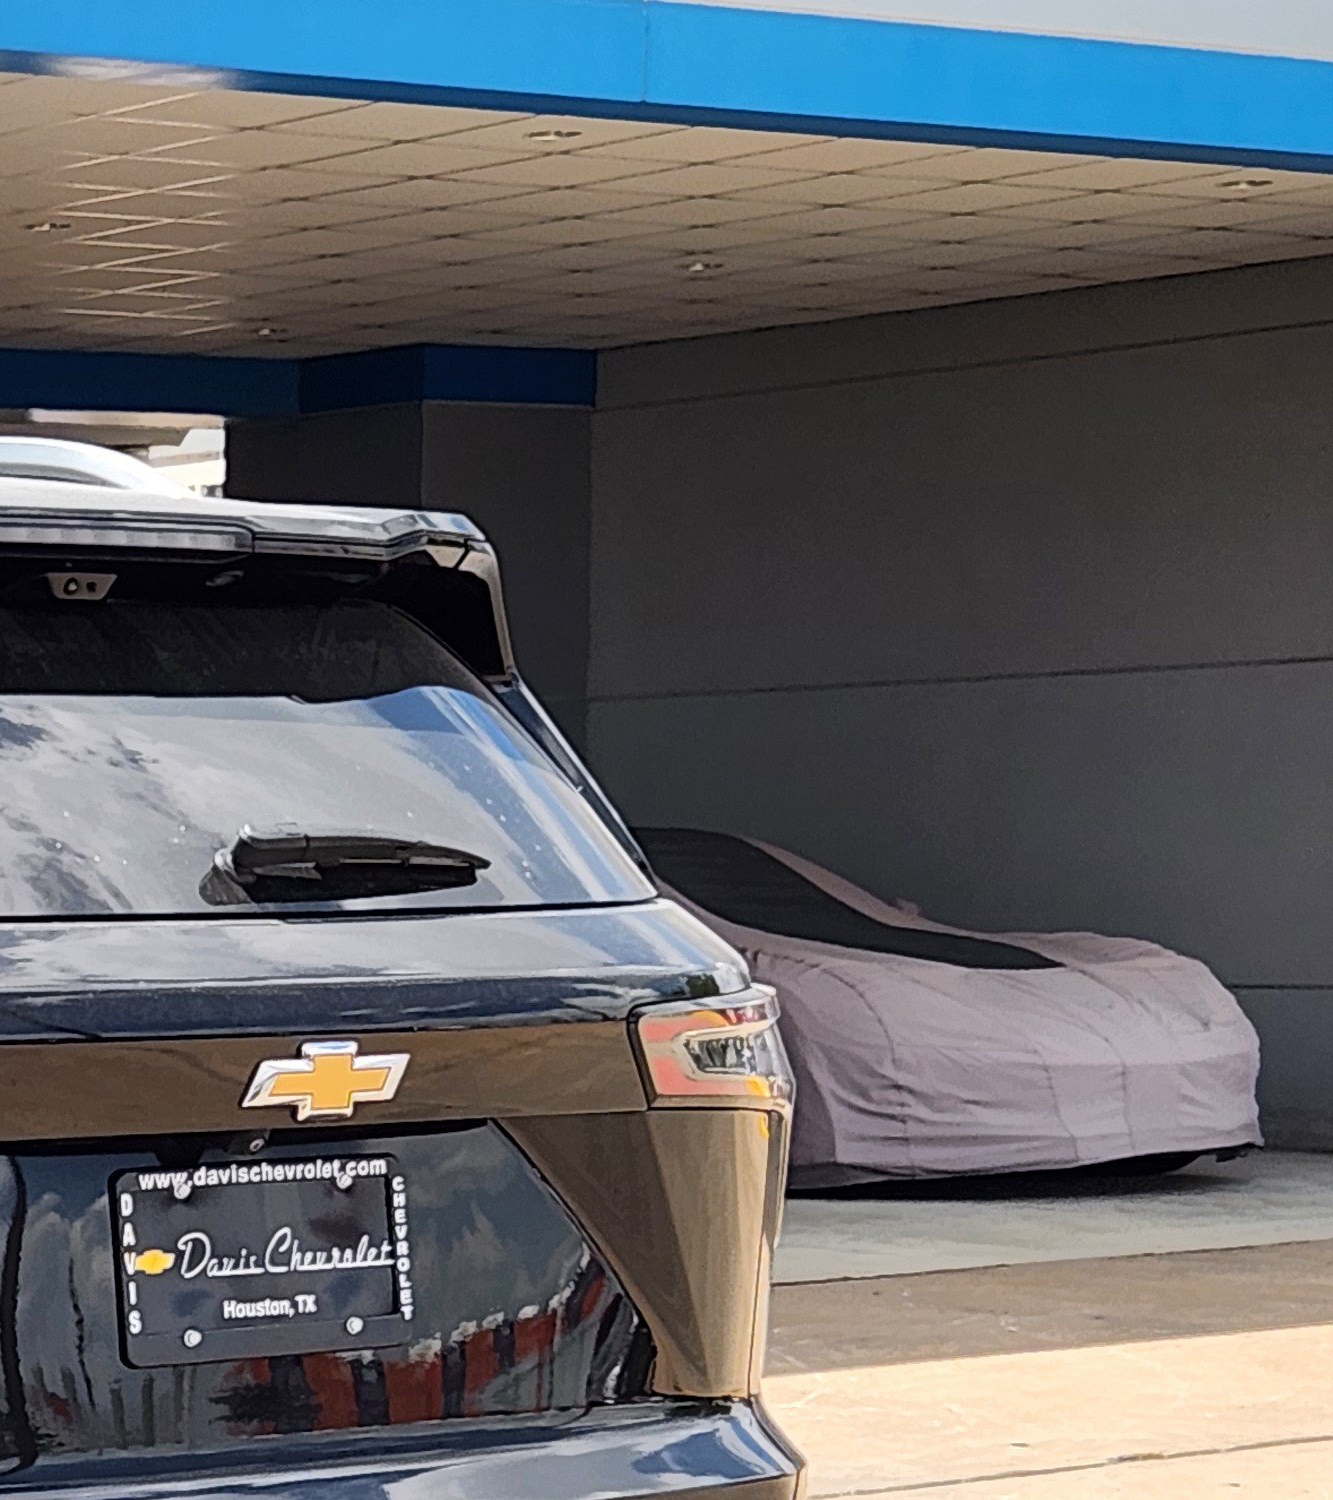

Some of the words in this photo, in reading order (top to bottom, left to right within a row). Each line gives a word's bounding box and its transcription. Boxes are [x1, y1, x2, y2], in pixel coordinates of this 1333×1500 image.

[138, 1158, 388, 1190] www.davischevrolet.com
[120, 1192, 143, 1335] DAVIS
[177, 1231, 265, 1279] Davis
[263, 1226, 396, 1274] Chevrolet
[391, 1175, 414, 1321] CHEVROLET
[222, 1298, 295, 1320] Houston,
[294, 1293, 318, 1315] TX
